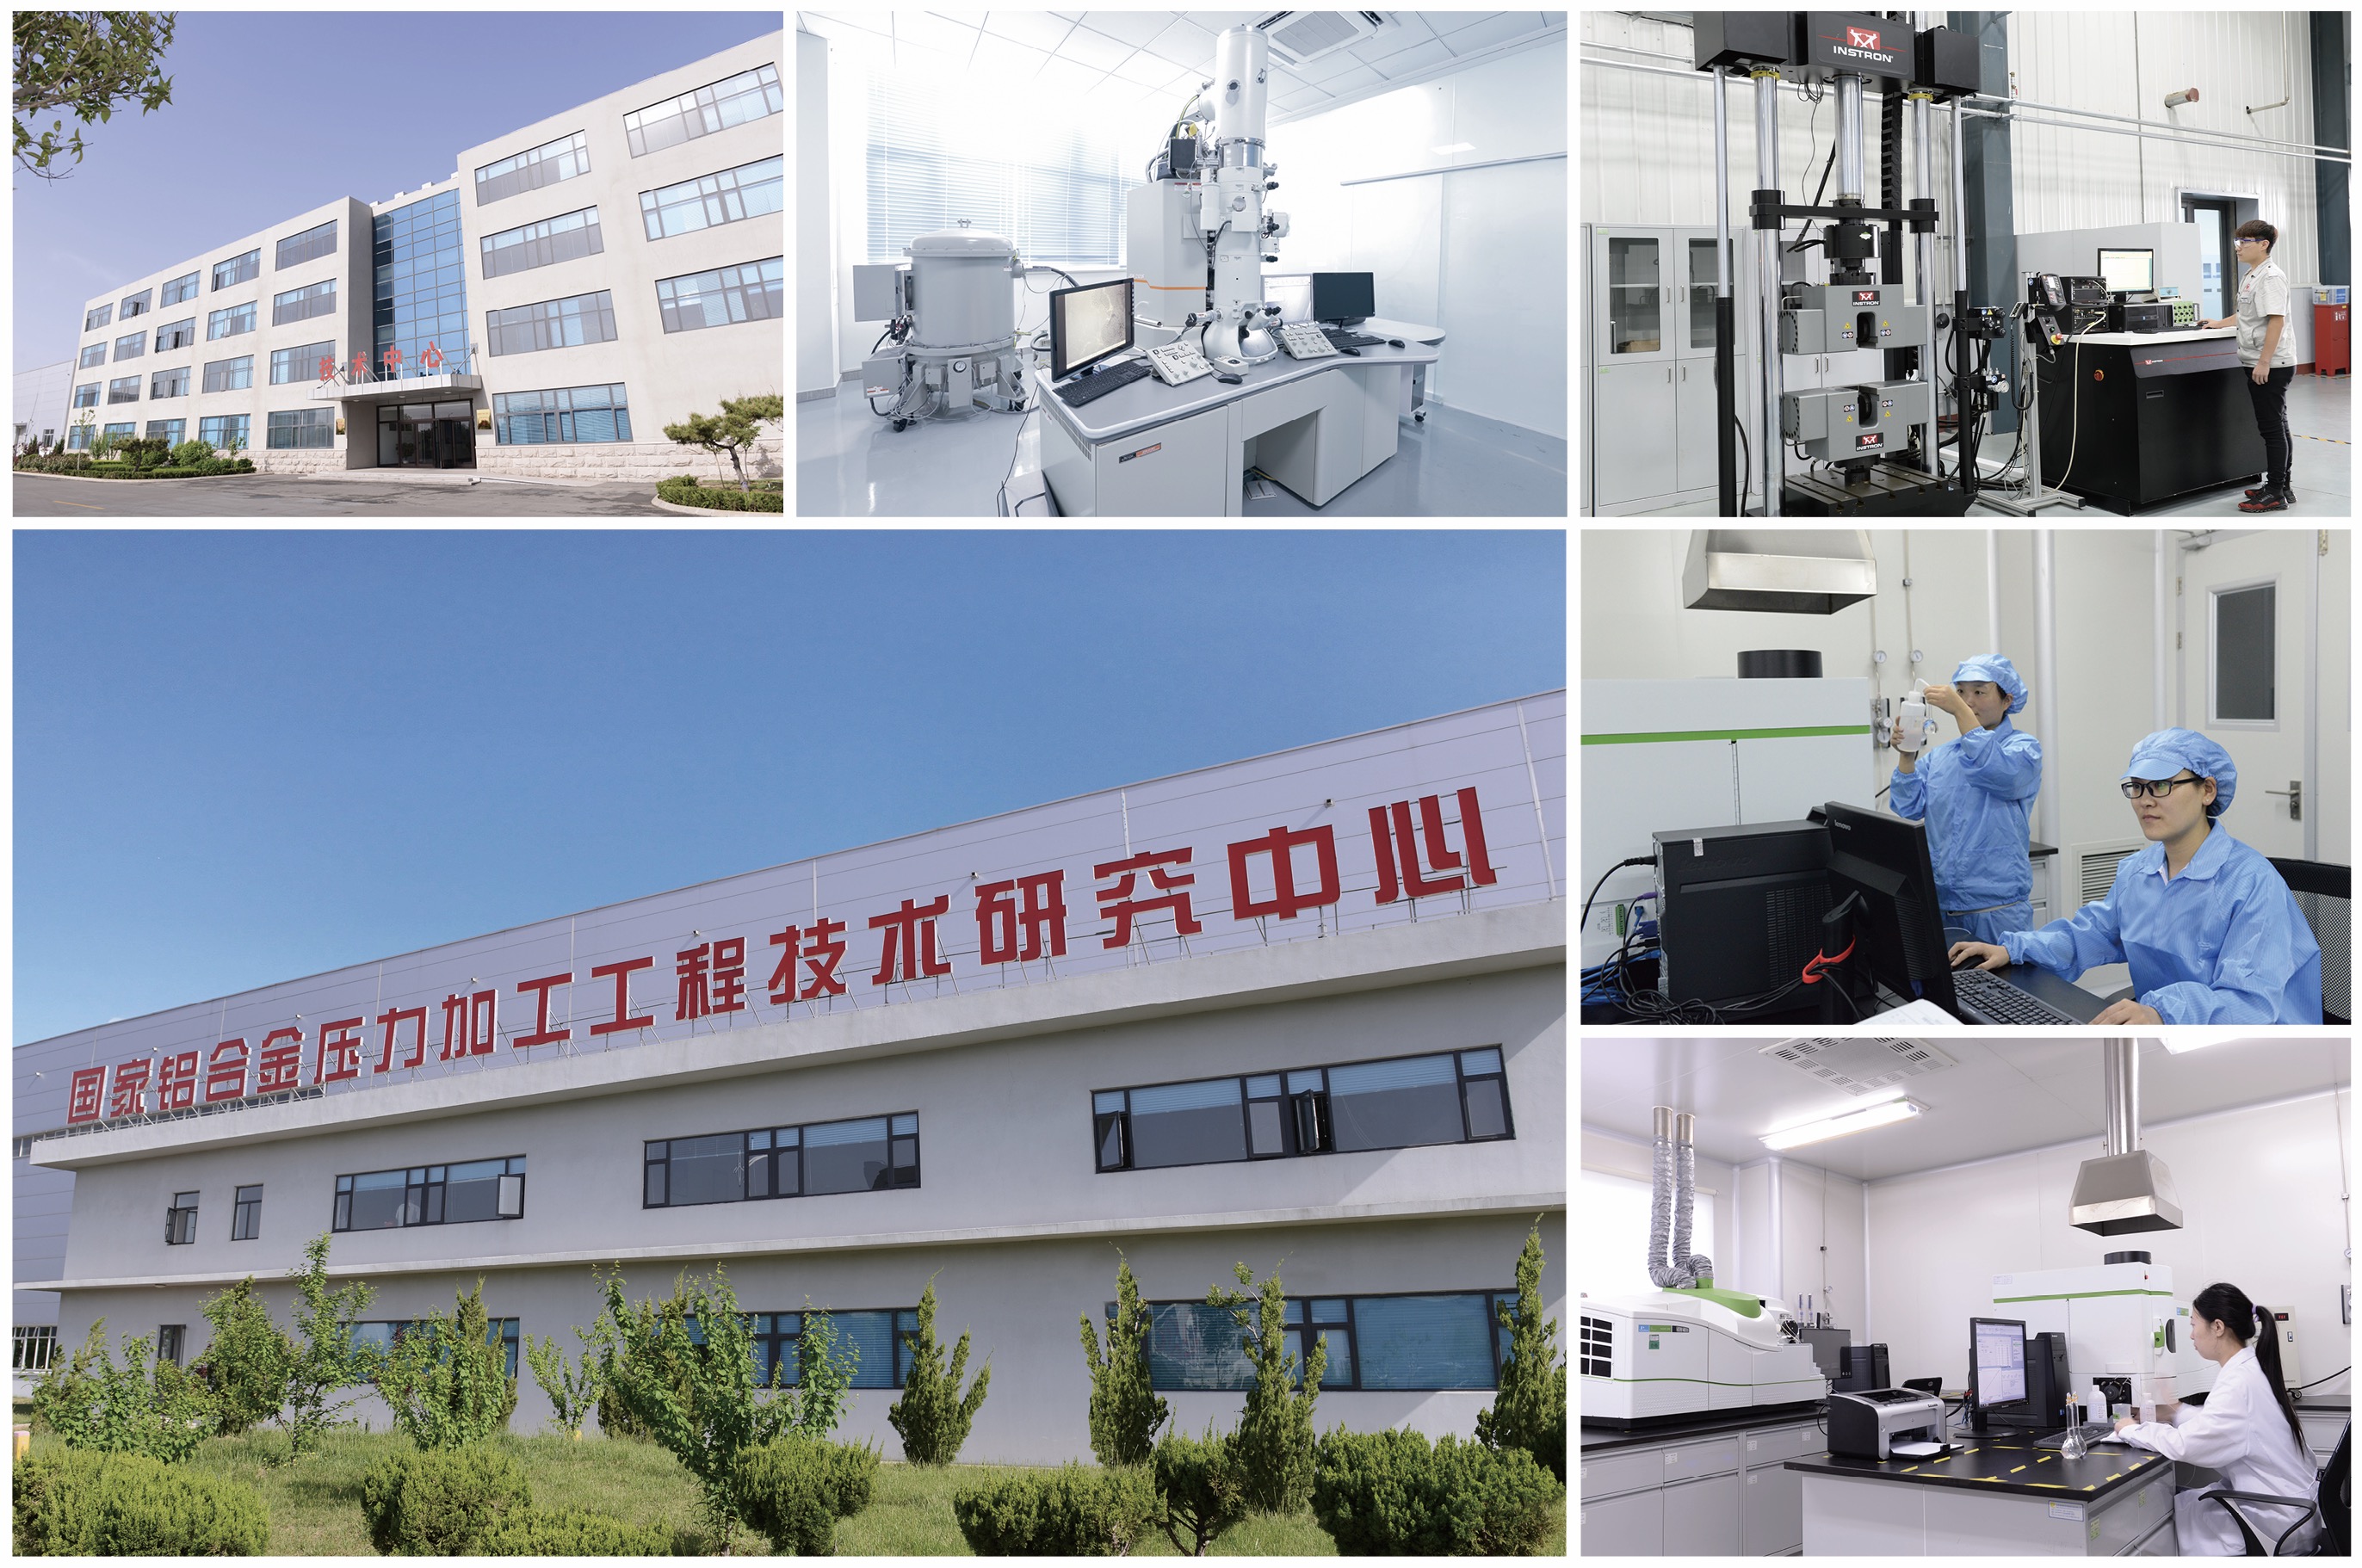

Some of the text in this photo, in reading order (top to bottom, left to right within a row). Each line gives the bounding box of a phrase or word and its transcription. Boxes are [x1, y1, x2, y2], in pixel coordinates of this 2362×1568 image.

[1833, 46, 1893, 63] INSTRON
[318, 341, 443, 381] 技术中心
[67, 787, 1498, 1124] 国家铝合金压力加工工程技术研究中心
